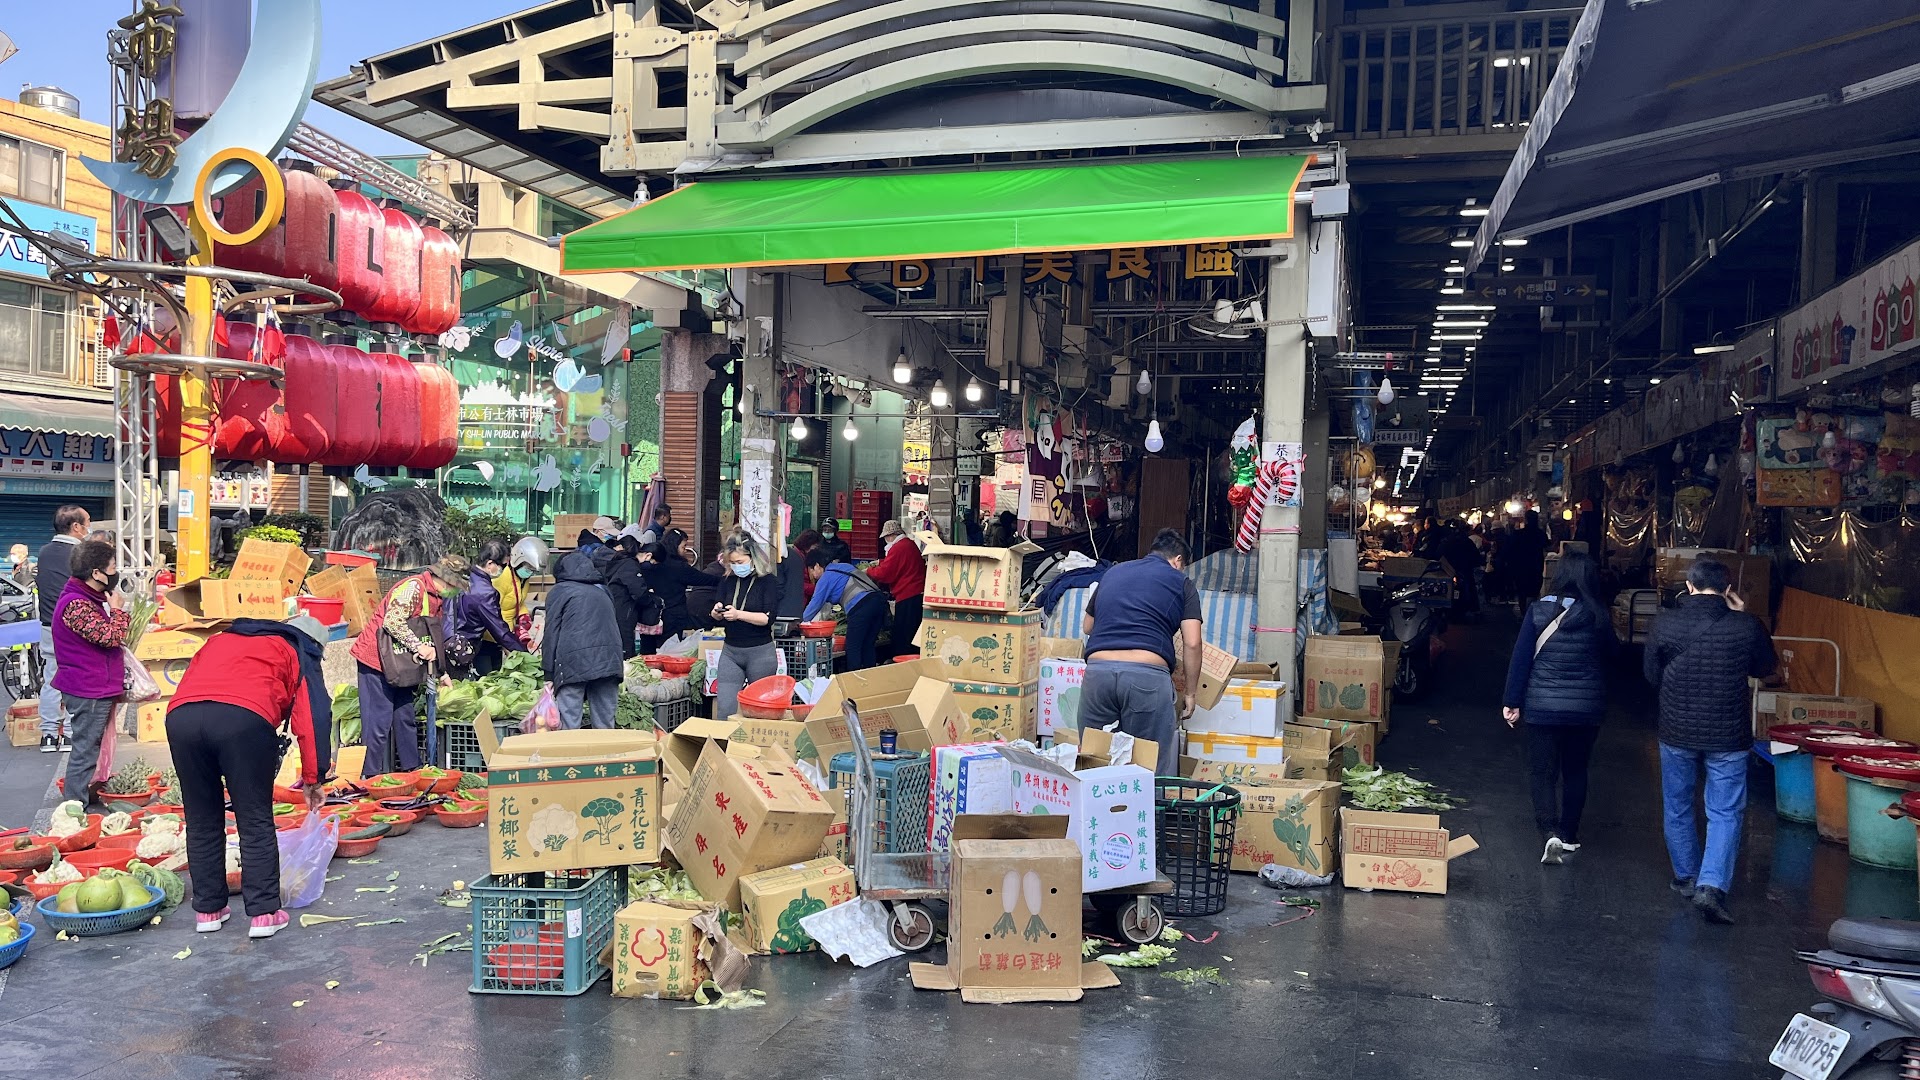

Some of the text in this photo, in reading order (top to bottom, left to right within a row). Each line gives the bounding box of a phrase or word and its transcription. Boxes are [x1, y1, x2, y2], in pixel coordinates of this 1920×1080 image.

[116, 0, 184, 179] 市場
[53, 221, 90, 237] 士林二店
[1872, 293, 1920, 348] Spo
[526, 335, 564, 363] Share
[1793, 321, 1840, 374] Sport
[493, 430, 520, 439] PUBLIC
[930, 564, 940, 592] 特選
[992, 568, 1002, 597] 甜玉米
[932, 611, 1008, 624] 川林合作社
[1043, 686, 1052, 727] 包心白菜
[508, 763, 637, 783] 川林合作社
[1091, 779, 1142, 799] 包心白菜
[498, 795, 521, 861] 花椰菜
[1371, 863, 1391, 873] 台東
[615, 923, 630, 993] 分級包裝
[666, 927, 683, 998] 品質保證
